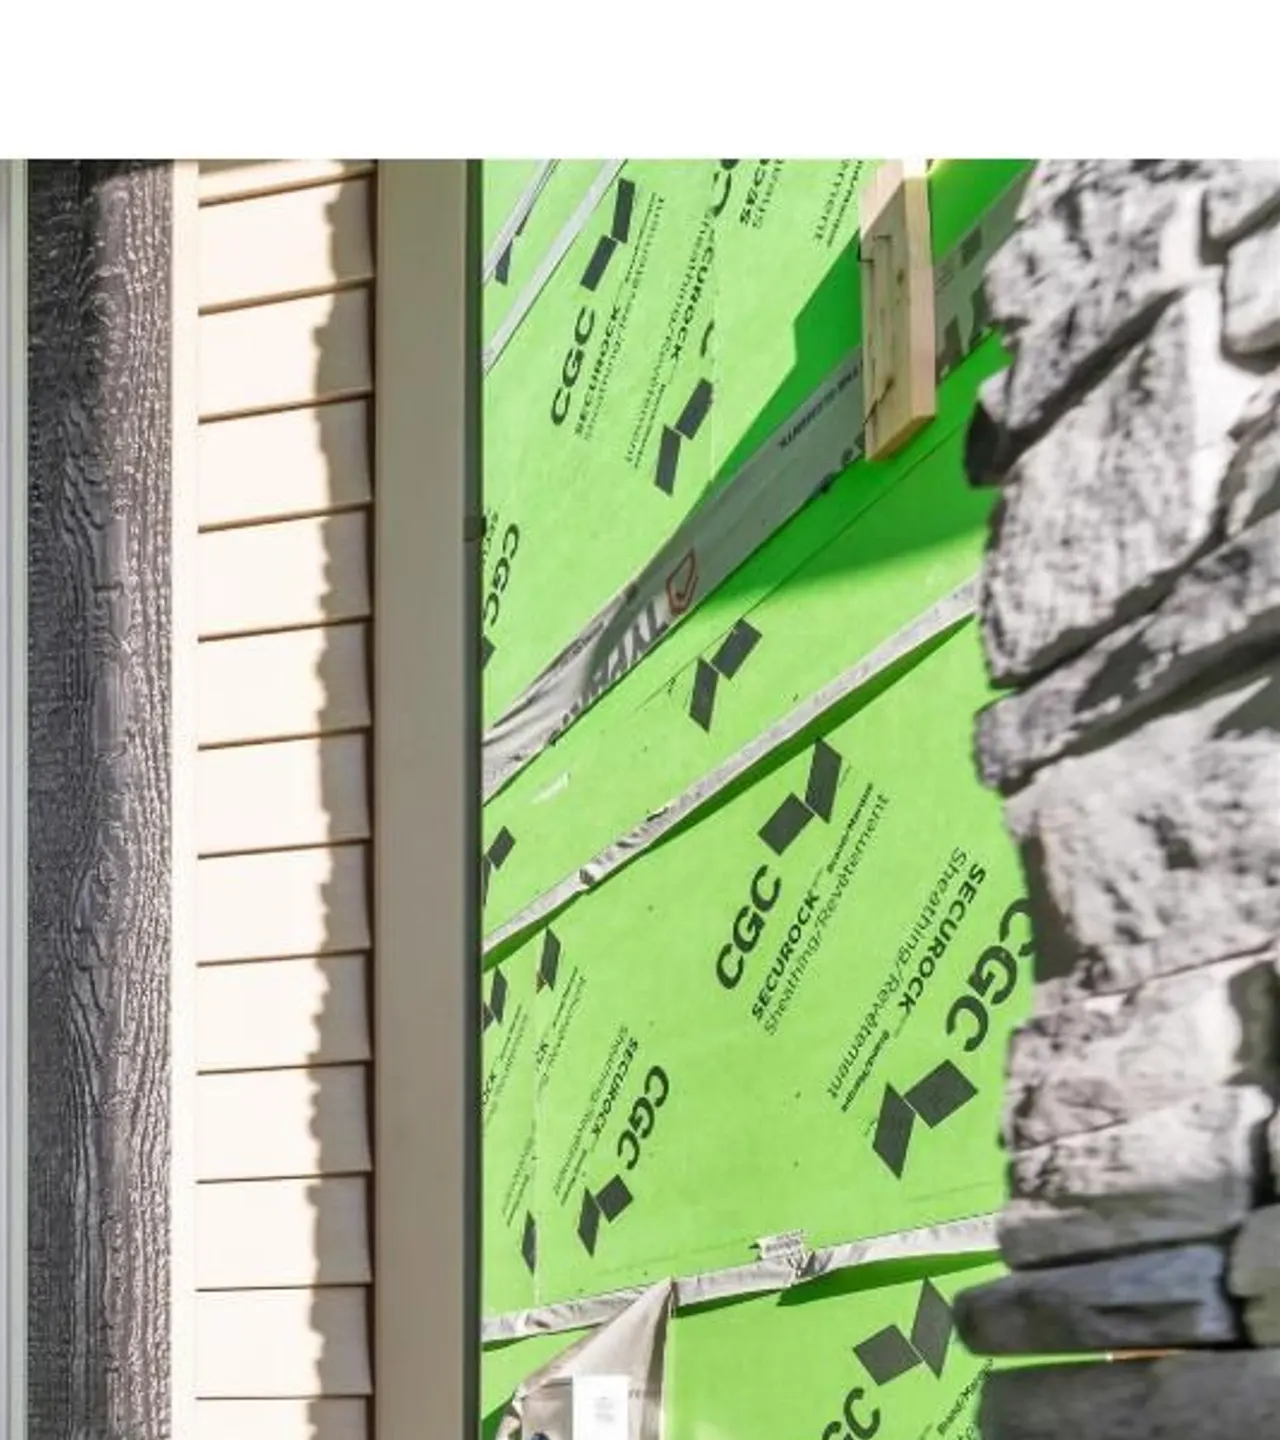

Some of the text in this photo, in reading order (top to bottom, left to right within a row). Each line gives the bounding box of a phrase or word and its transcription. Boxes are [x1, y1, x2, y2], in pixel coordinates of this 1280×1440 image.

[550, 304, 595, 425] CGC
[483, 522, 520, 628] CGC
[716, 864, 782, 990] CGC
[751, 888, 820, 1021] SECUROCK
[898, 863, 987, 1014] SECUROCK
[947, 897, 1035, 1052] CGC
[591, 1038, 639, 1136] SECUROCK
[617, 1065, 670, 1170] CGC
